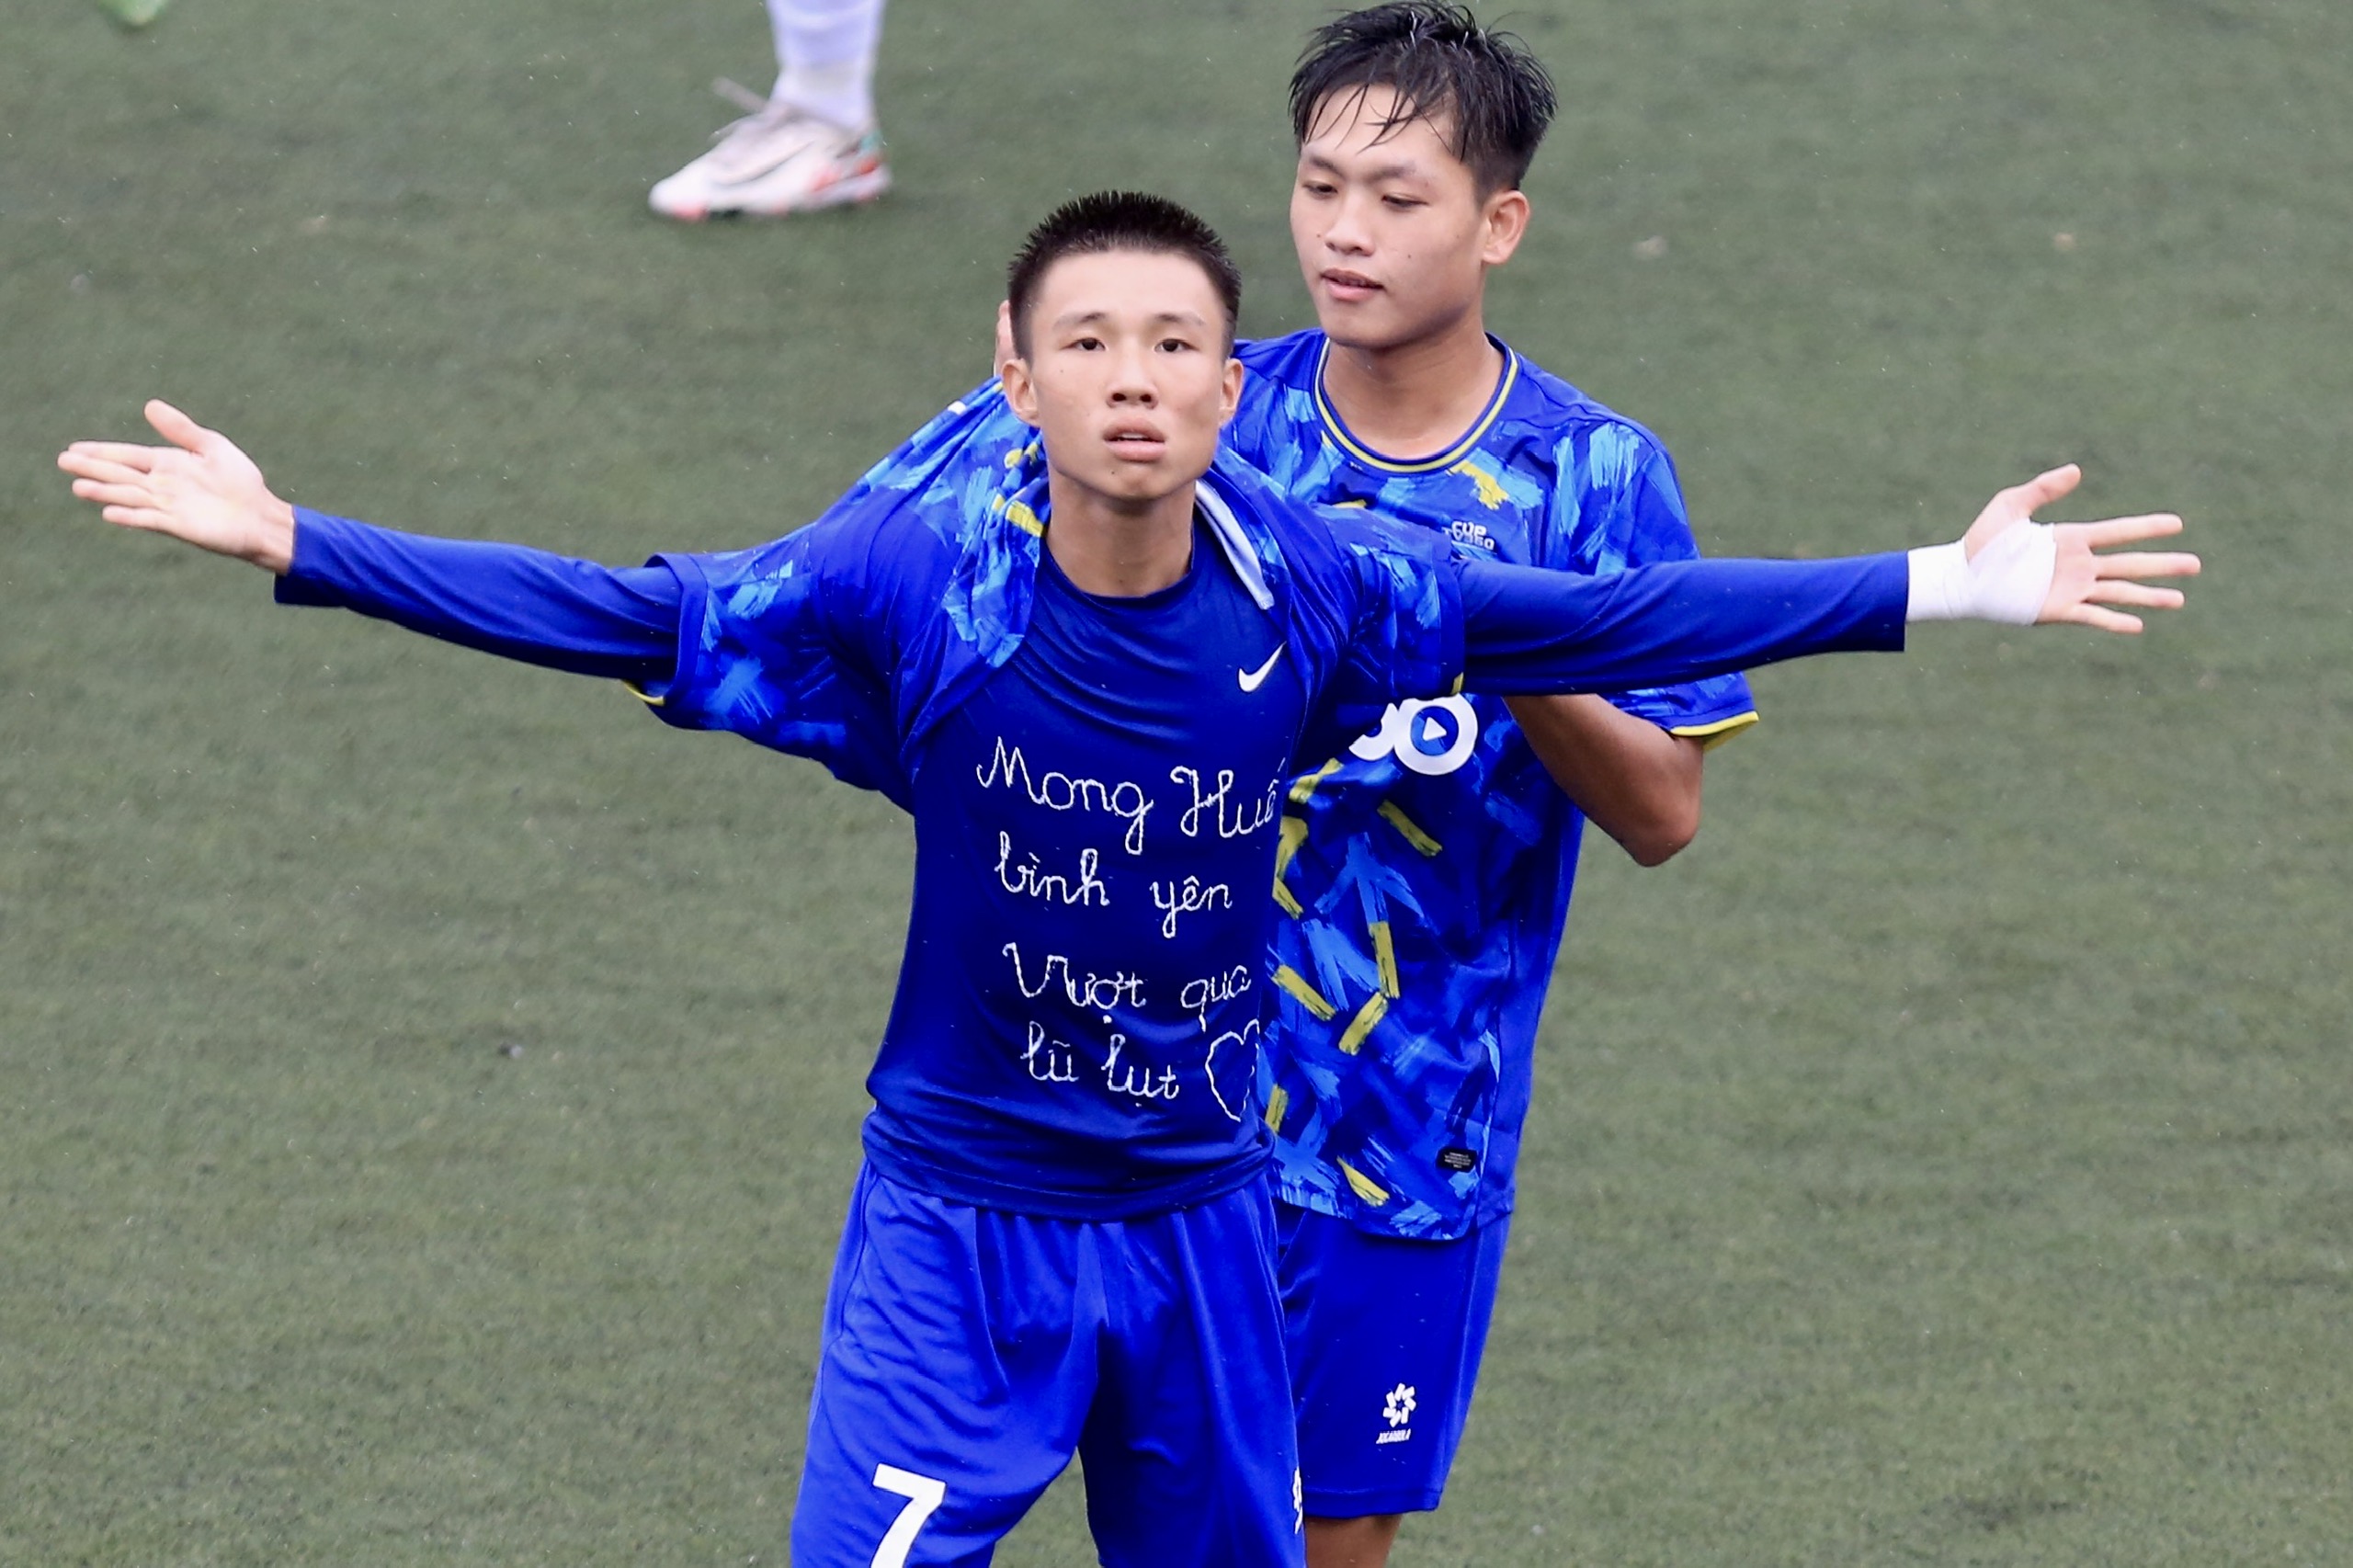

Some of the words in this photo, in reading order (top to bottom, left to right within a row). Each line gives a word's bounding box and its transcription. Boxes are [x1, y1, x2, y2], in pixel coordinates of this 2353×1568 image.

[1452, 520, 1486, 537] CUP
[976, 736, 1154, 855] Mong
[1170, 757, 1285, 838] Huế
[994, 831, 1110, 906] bình
[1149, 875, 1233, 938] yên
[1002, 942, 1146, 1024] Vượt
[1180, 965, 1252, 1032] qua
[1020, 1021, 1079, 1083] lũ
[1101, 1034, 1180, 1108] lụt
[871, 1462, 947, 1568] 7
